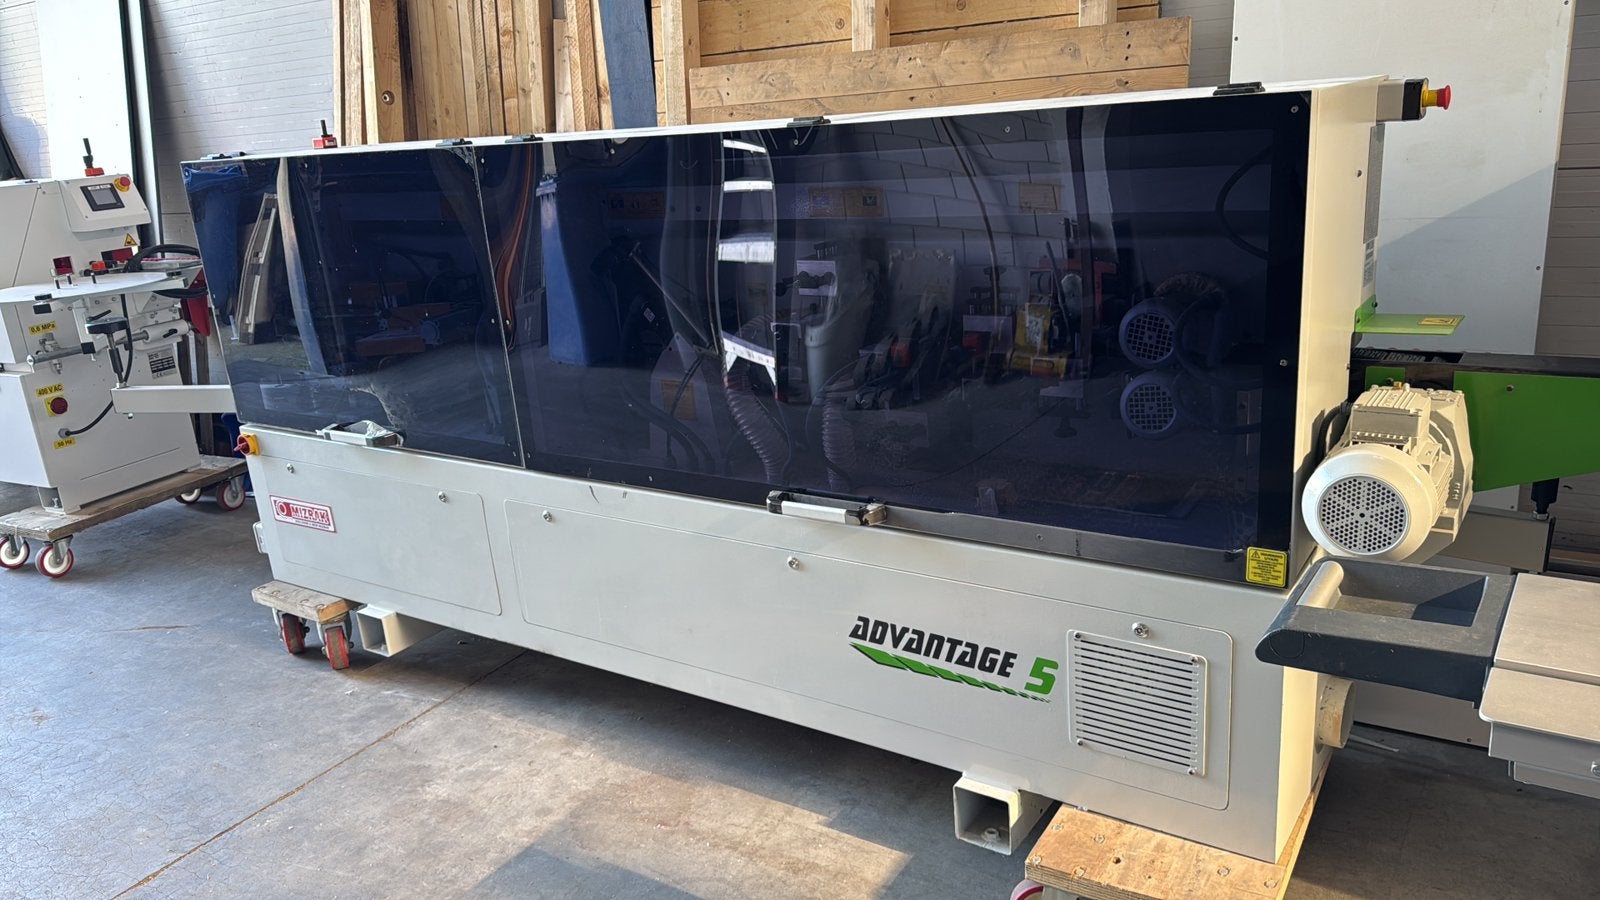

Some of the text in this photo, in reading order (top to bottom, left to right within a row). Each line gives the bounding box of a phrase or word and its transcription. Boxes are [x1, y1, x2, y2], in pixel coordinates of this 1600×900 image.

[42, 322, 56, 332] MPa
[37, 387, 48, 396] 400
[290, 504, 329, 525] MIZRAK
[848, 616, 1018, 678] ADVANTAGE
